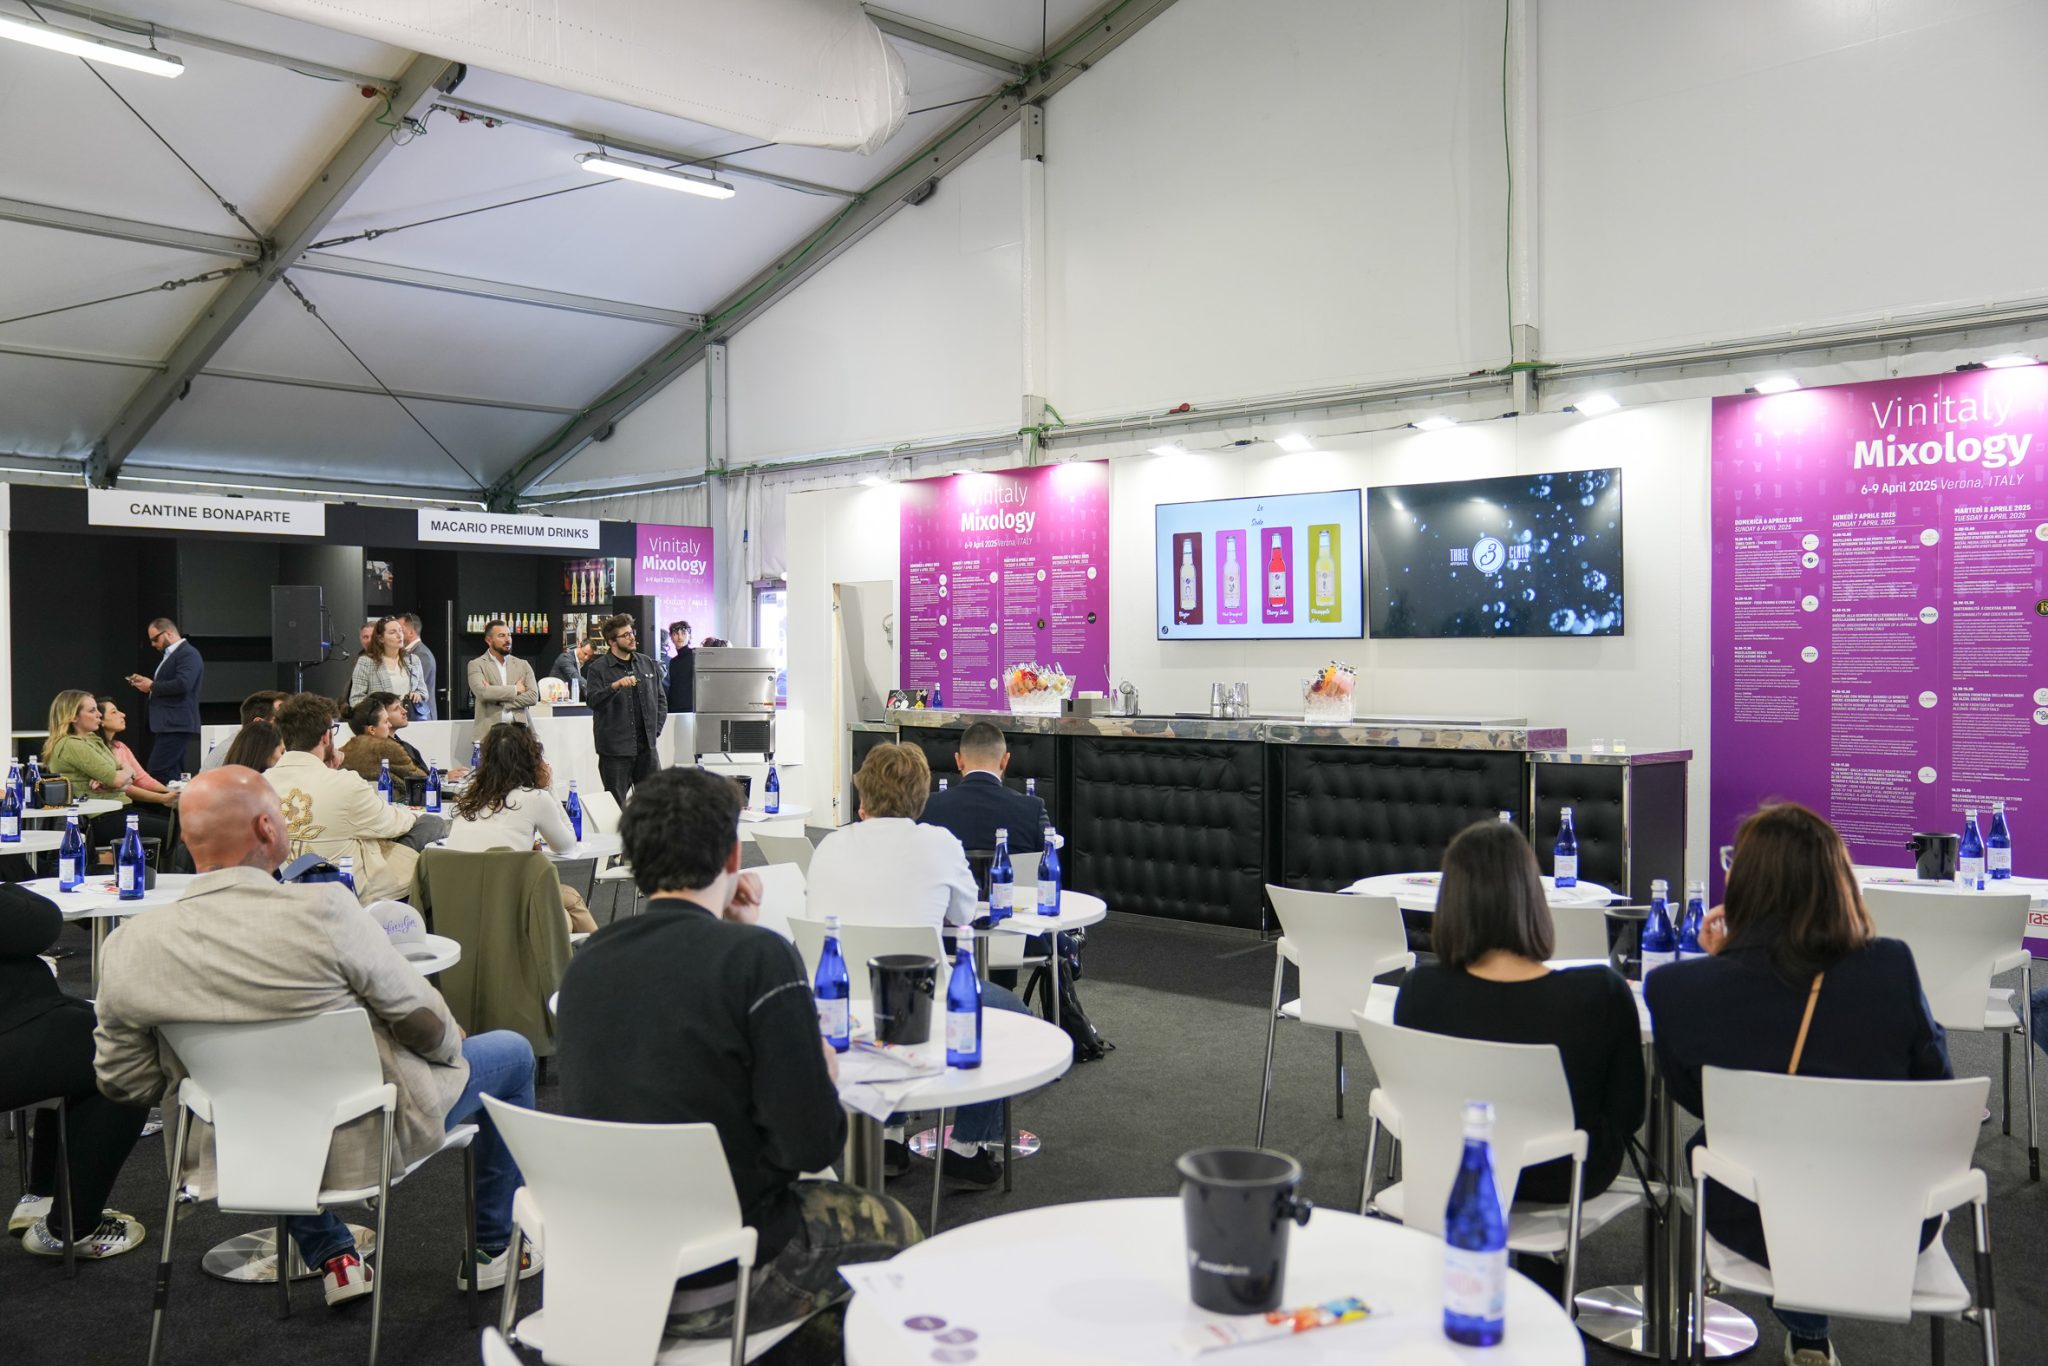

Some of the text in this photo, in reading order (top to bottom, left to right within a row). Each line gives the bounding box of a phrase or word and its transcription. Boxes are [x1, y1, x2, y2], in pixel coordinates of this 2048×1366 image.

[1871, 389, 2014, 429] Vinitaly
[1853, 431, 2033, 470] Mixology
[1861, 474, 2025, 496] 6-9 April 2025 Verona, ITALY
[129, 503, 291, 523] CANTINE BONAPARTE
[1832, 512, 1854, 521] LUNEDÌ
[1954, 505, 1983, 514] MARTEDÌ
[430, 520, 589, 539] MACARIO PREMIUM DRINKS
[961, 508, 1036, 534] Mixology
[648, 536, 701, 557] Vinitaly
[973, 540, 984, 549] April
[985, 539, 997, 547] 2025
[1017, 537, 1033, 545] ITALY
[1450, 548, 1468, 561] THREE
[1509, 545, 1530, 559] CENTS
[642, 554, 707, 576] Mixology
